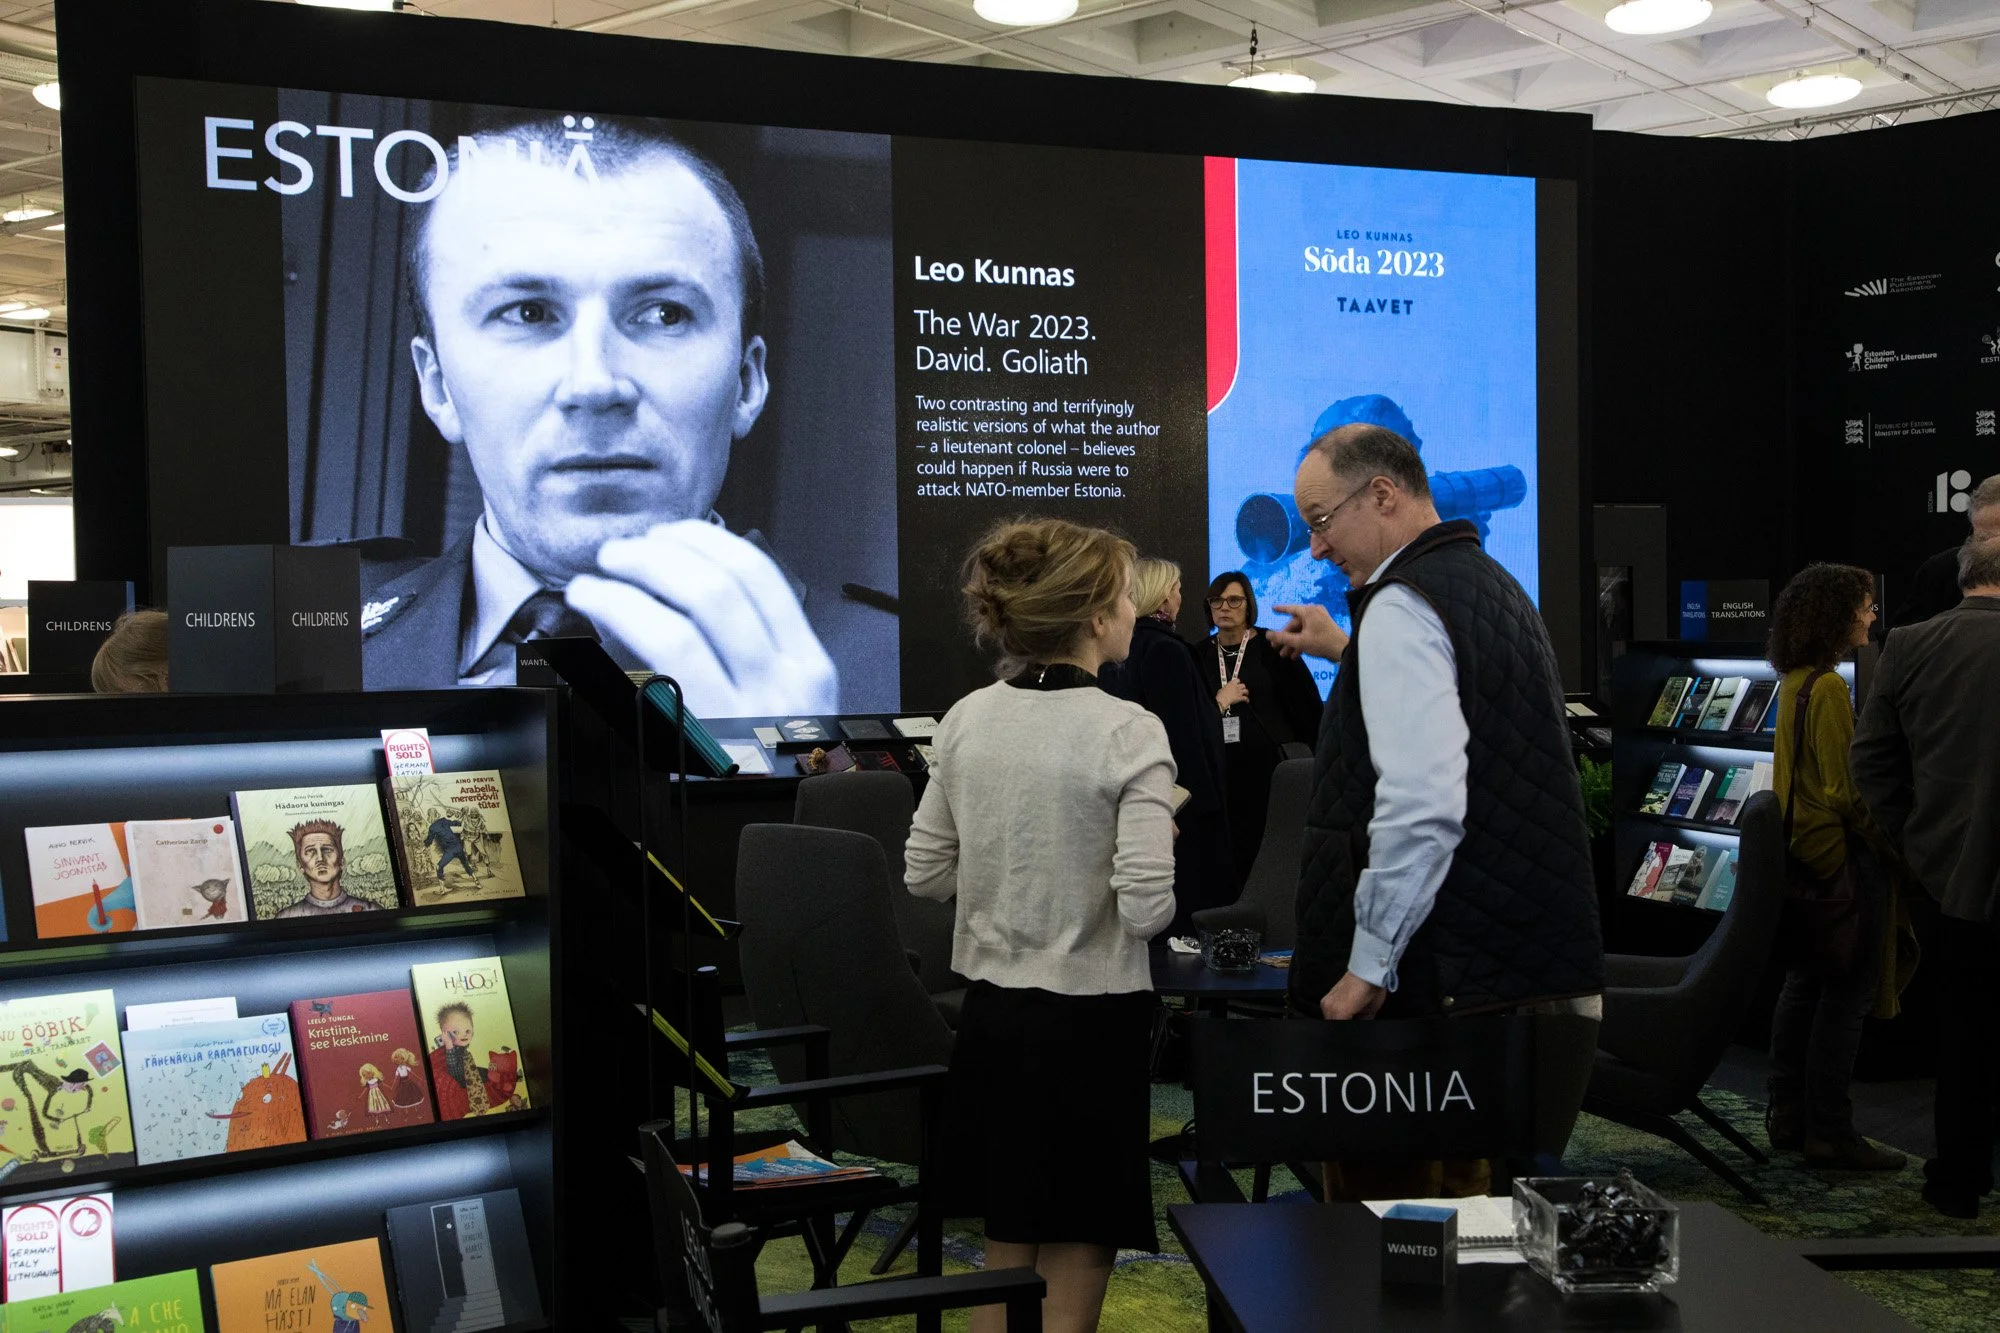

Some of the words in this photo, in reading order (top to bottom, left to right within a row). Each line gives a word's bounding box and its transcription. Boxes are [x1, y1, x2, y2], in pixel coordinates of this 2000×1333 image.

[1336, 229, 1360, 240] LEO
[1366, 231, 1413, 243] KUNNAS
[1304, 246, 1371, 275] Sõda
[1377, 249, 1445, 278] 2023
[914, 256, 965, 282] Leo
[974, 258, 1075, 287] Kunnas
[1337, 297, 1414, 315] TAAVET
[914, 309, 961, 336] The
[968, 312, 1020, 338] War
[1029, 314, 1096, 340] 2023.
[916, 345, 992, 373] David.
[1002, 348, 1088, 375] Goliath
[1864, 350, 1895, 358] Estonian
[1900, 352, 1938, 361] Literature
[915, 395, 945, 411] Two
[950, 397, 1028, 414] contrasting
[1033, 398, 1058, 413] and
[1063, 399, 1135, 417] terrifyingly
[916, 417, 968, 432] realistic
[974, 419, 1028, 433] versions
[1033, 419, 1046, 434] of
[1051, 420, 1085, 434] what
[1091, 420, 1112, 435] the
[1116, 421, 1160, 436] author
[930, 442, 938, 453] a
[943, 438, 1012, 454] lieutenant
[1017, 440, 1066, 455] colonel
[1083, 441, 1135, 456] believes
[917, 460, 955, 475] could
[961, 461, 1013, 478] happen
[1018, 461, 1027, 475] if
[1032, 462, 1072, 476] Russia
[1077, 465, 1110, 477] were
[1115, 464, 1129, 477] to
[917, 481, 960, 496] attack
[966, 482, 1069, 498] NATO-member
[1074, 483, 1126, 498] Estonia.
[185, 611, 256, 629] CHILDRENS
[292, 611, 349, 628] CHILDRENS
[1711, 610, 1766, 618] TRANSLATIONS
[46, 620, 111, 632] CHILDRENS
[389, 743, 426, 752] RIGHTS
[395, 751, 422, 760] SOLD
[275, 802, 309, 810] Hädaoru
[311, 800, 345, 808] kuningas
[328, 1015, 355, 1023] TUNGAL
[22, 1016, 85, 1041] ÖÖBIK
[308, 1024, 361, 1039] Kristiina,
[310, 1040, 330, 1050] see
[333, 1032, 390, 1047] keskmine
[208, 1042, 282, 1060] RAAMATUKOGU
[1252, 1070, 1476, 1115] ESTONIA
[10, 1221, 54, 1233] RIGHTS
[16, 1231, 48, 1241] SOLD
[9, 1246, 56, 1258] GERMANY
[1387, 1242, 1438, 1257] WANTED
[9, 1259, 40, 1269] ITALY
[264, 1288, 282, 1311] MA
[290, 1285, 316, 1307] ELAN
[265, 1308, 312, 1331] HÄSTI
